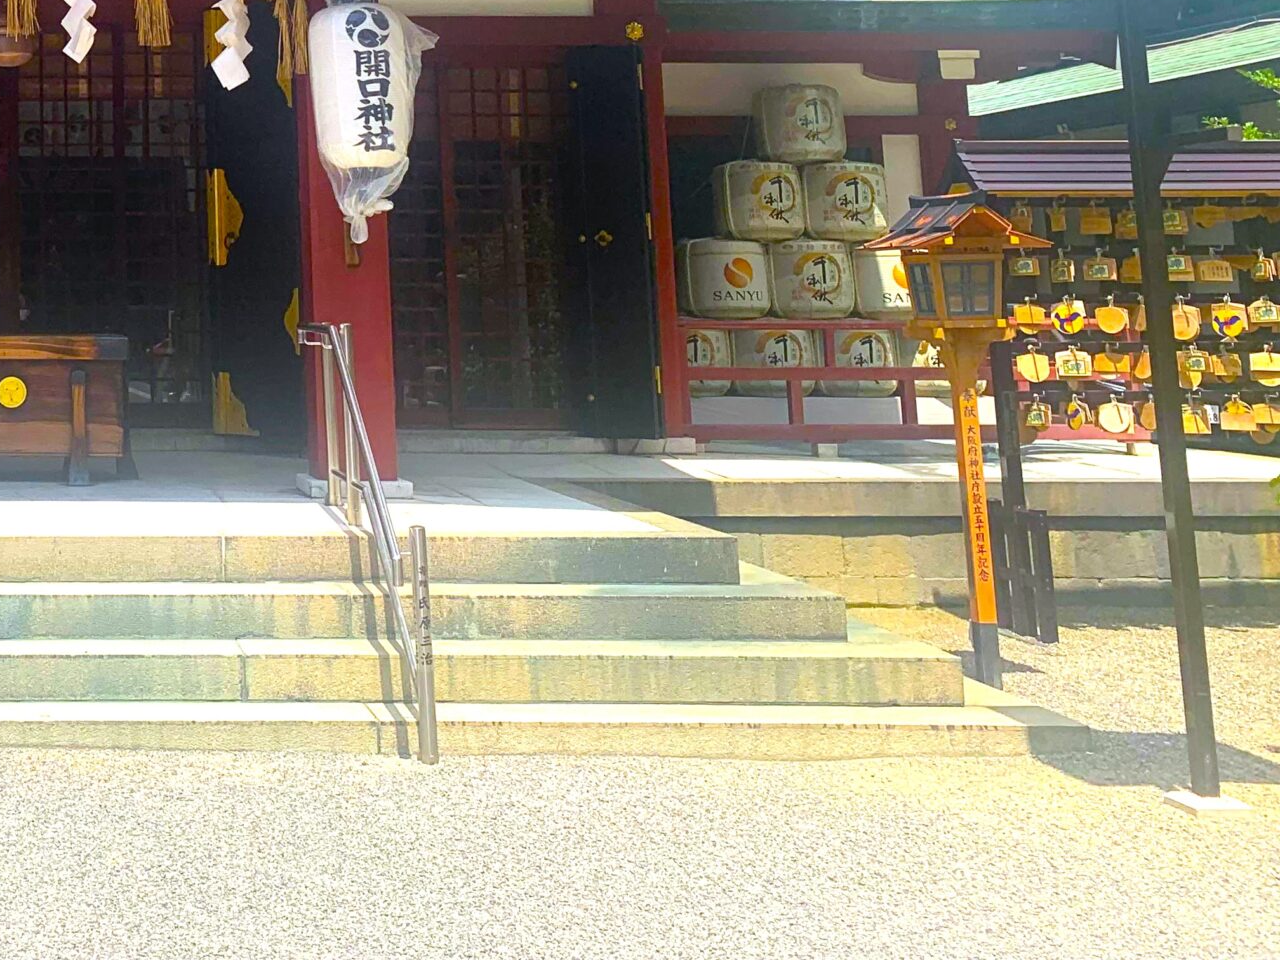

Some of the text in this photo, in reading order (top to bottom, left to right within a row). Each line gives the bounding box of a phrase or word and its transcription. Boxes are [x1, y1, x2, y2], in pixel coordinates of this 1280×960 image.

[353, 49, 395, 152] 開口神社
[713, 290, 764, 303] SANYU
